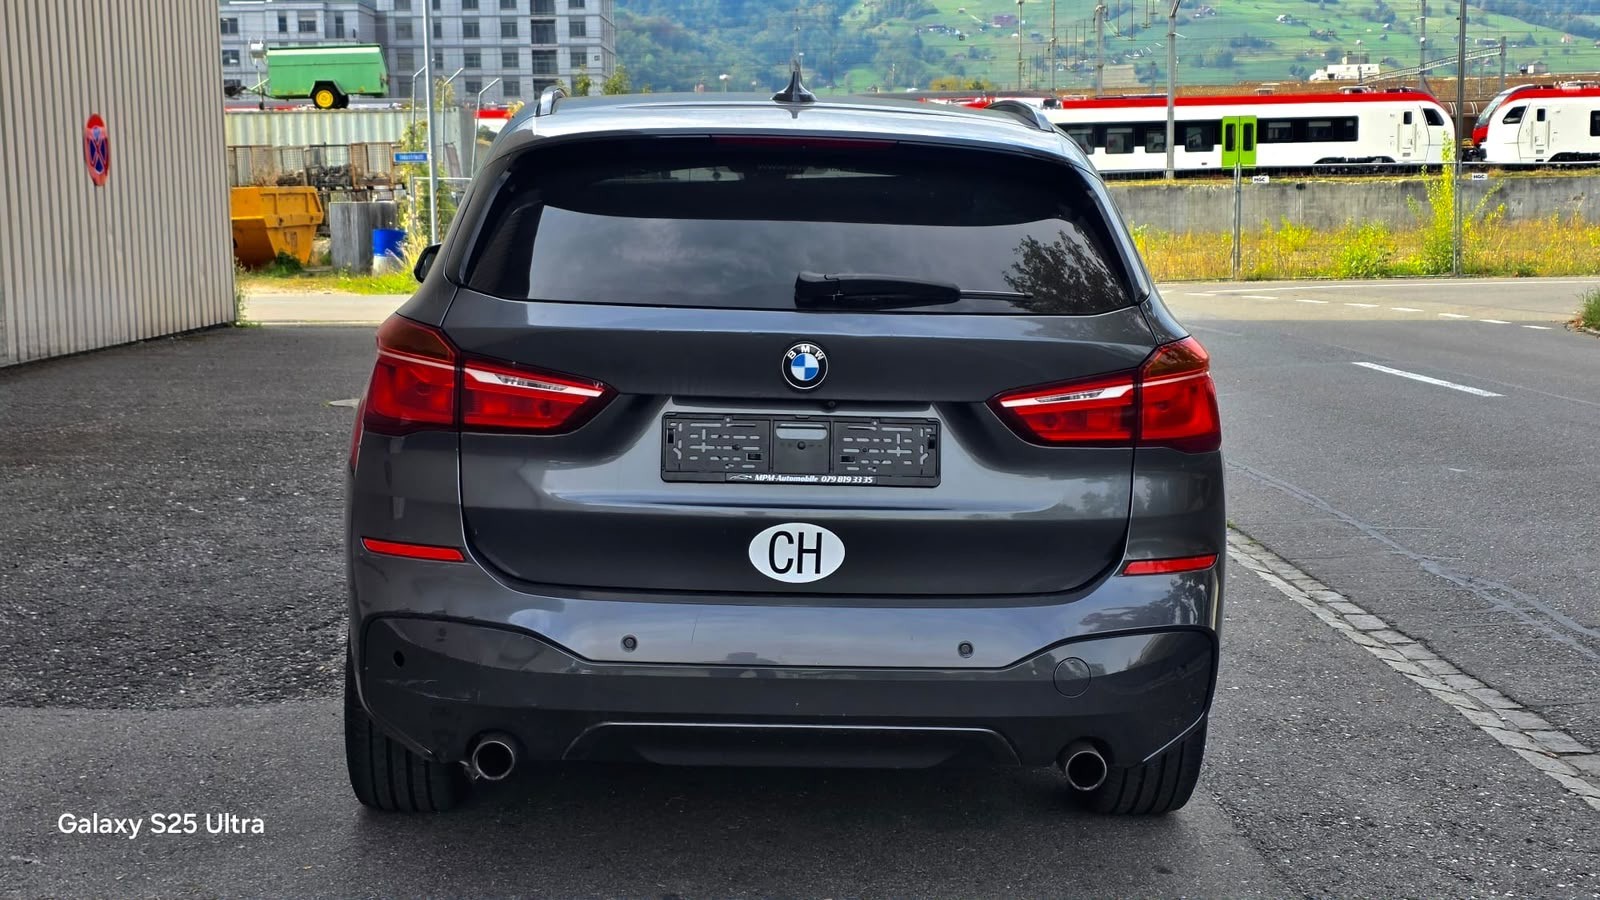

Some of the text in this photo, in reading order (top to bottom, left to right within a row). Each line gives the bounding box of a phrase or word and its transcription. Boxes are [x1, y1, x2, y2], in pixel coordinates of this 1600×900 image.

[787, 345, 825, 360] BMW
[754, 474, 818, 483] MPM-Automobile
[821, 475, 836, 483] 079
[863, 476, 873, 484] 35
[768, 530, 822, 575] CH
